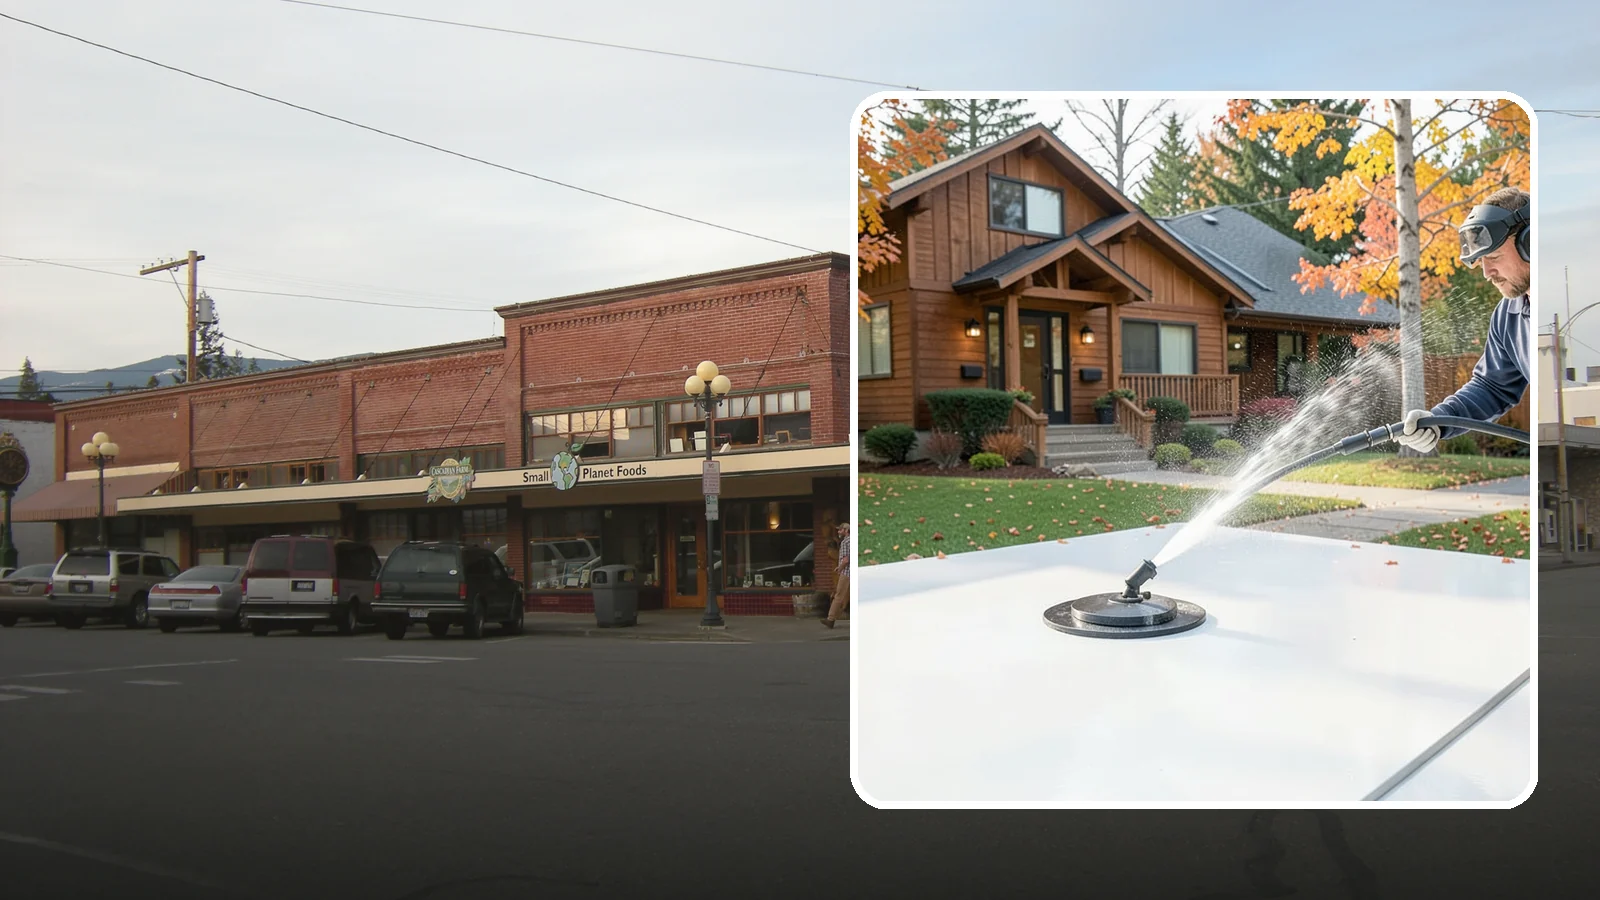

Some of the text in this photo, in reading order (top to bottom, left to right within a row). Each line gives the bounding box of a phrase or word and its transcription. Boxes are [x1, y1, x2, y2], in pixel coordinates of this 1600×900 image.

[523, 464, 647, 483] Small Planet Foods
